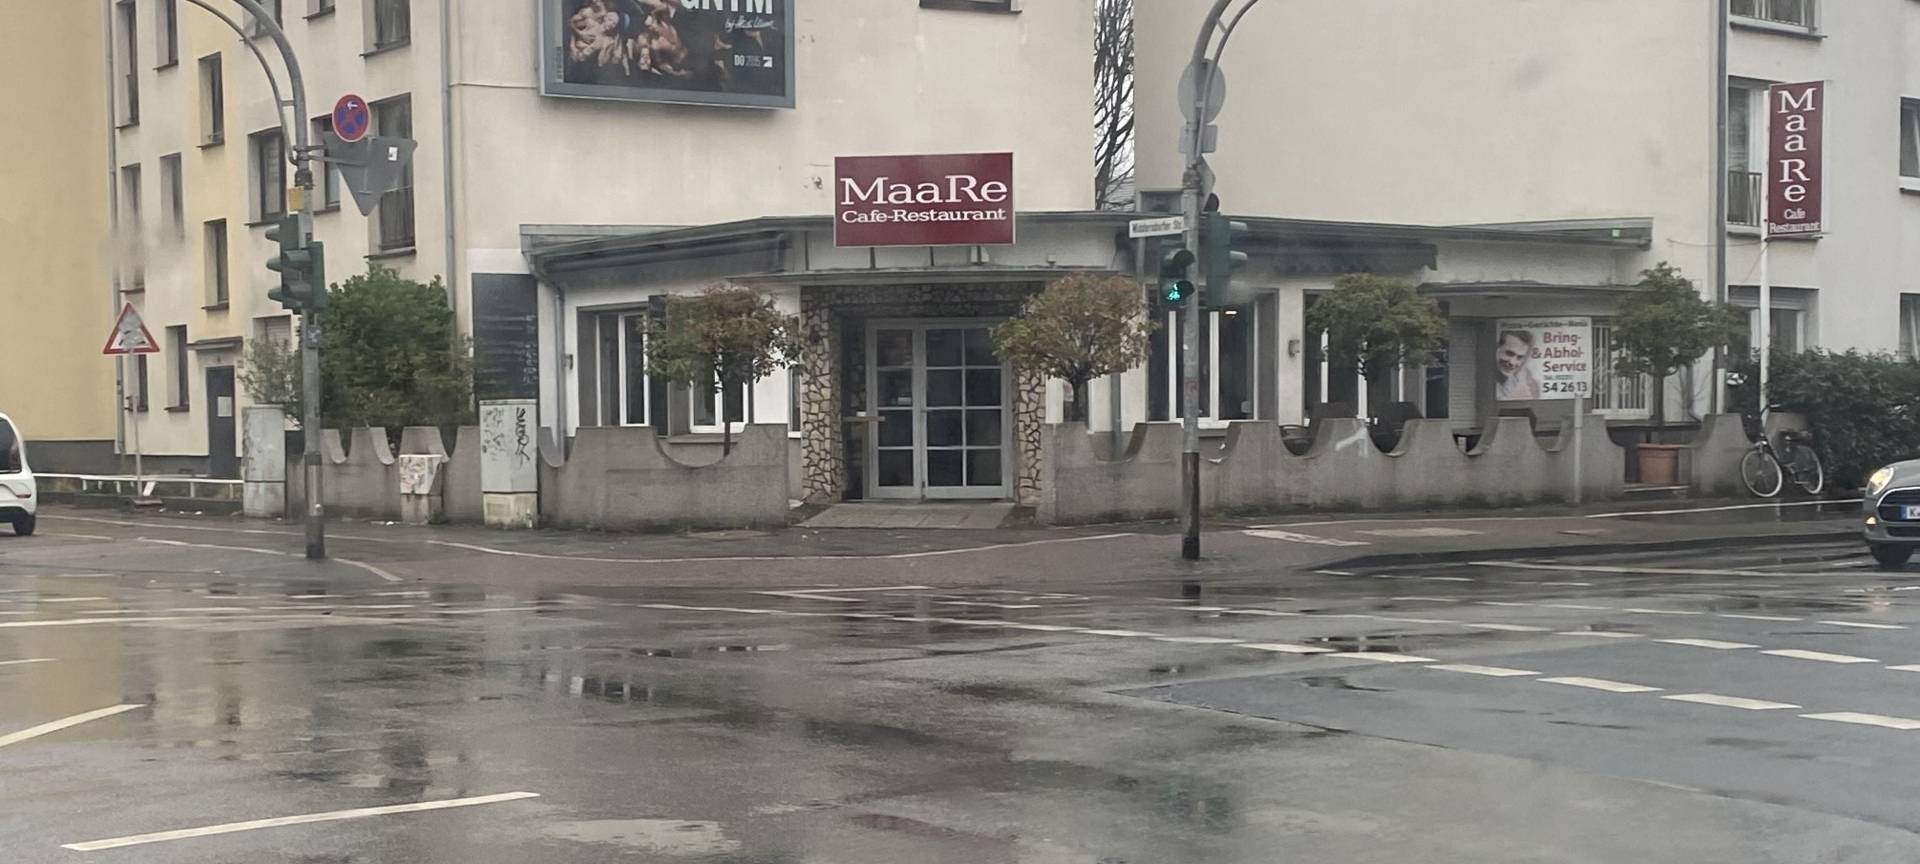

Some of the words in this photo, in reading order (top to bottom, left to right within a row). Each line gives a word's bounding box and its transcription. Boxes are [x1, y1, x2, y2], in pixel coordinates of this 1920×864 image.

[1777, 87, 1817, 202] MaaRe
[840, 174, 1008, 205] MaaRe
[842, 207, 1007, 224] Cafe-Restaurant
[1784, 208, 1806, 220] Cafe
[1769, 221, 1821, 234] Restaurant
[1543, 331, 1581, 345] Bring-
[1530, 348, 1542, 359] &
[1544, 346, 1584, 359] Abhol-
[1542, 360, 1586, 373] Service
[1542, 382, 1558, 393] 54
[1560, 382, 1575, 392] 26
[1577, 381, 1588, 392] 13
